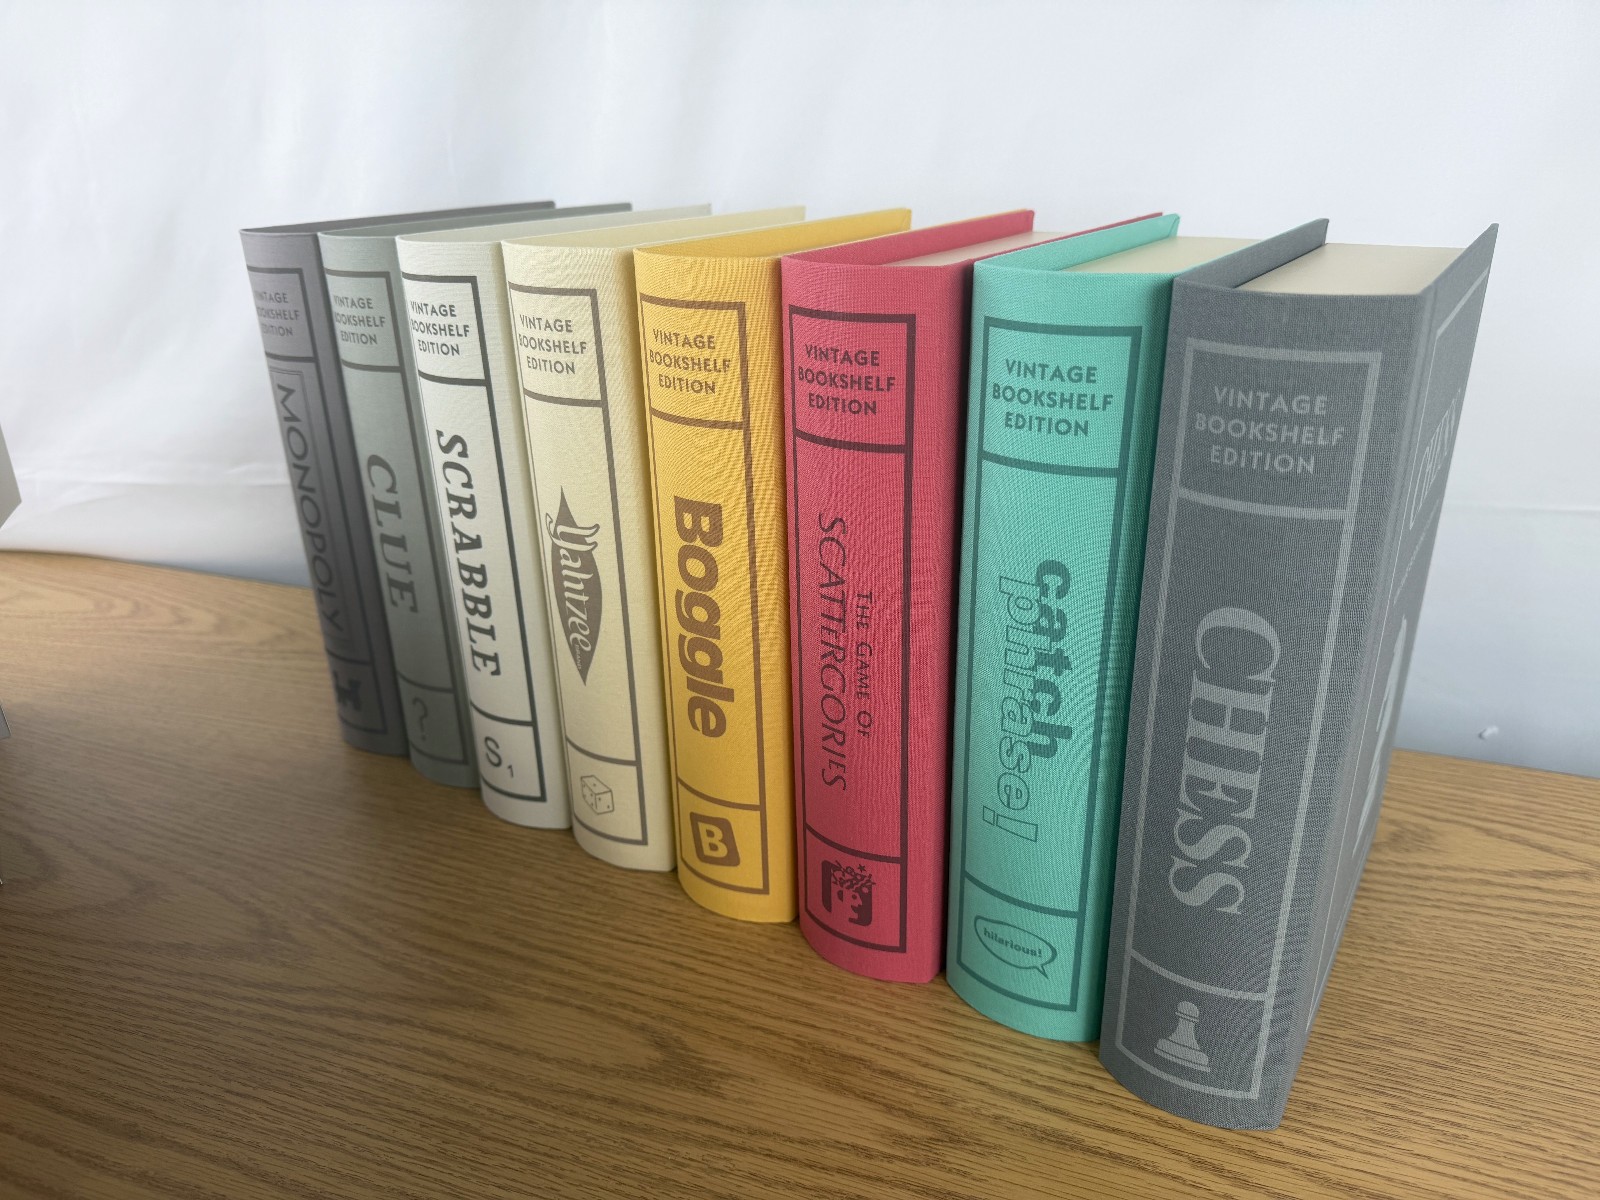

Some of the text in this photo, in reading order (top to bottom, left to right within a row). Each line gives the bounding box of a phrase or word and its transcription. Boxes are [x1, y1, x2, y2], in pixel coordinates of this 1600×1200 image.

[410, 301, 457, 318] VINTAGE
[519, 314, 573, 333] VINTAGE
[340, 331, 378, 345] EDITION
[410, 318, 470, 338] BOOKSHELF
[653, 328, 716, 350] VINTAGE
[417, 339, 460, 356] EDITION
[519, 333, 588, 355] BOOKSHELF
[805, 343, 880, 367] VINTAGE
[526, 355, 576, 375] EDITION
[649, 349, 731, 373] BOOKSHELF
[1005, 358, 1098, 384] VINTAGE
[658, 373, 716, 395] EDITION
[798, 366, 896, 392] BOOKSHELF
[808, 392, 877, 416] EDITION
[992, 383, 1114, 412] BOOKSHELF
[1213, 385, 1328, 416] VINTAGE
[1004, 412, 1090, 437] EDITION
[1195, 412, 1345, 447] BOOKSHELF
[1210, 444, 1316, 475] EDITION
[277, 383, 343, 632] MONOPOLY
[366, 453, 419, 614] CLUE
[436, 429, 501, 677] SCRABBLE
[545, 512, 600, 652] Yahtzee
[673, 495, 735, 739] Boggle
[818, 511, 847, 792] SCATTERGORIES
[856, 591, 873, 739] THE GAME OF
[1027, 559, 1073, 759] catch
[982, 575, 1052, 842] phrase!
[1168, 606, 1282, 915] CHESS
[700, 823, 728, 858] B
[983, 927, 1043, 958] hilarious!
